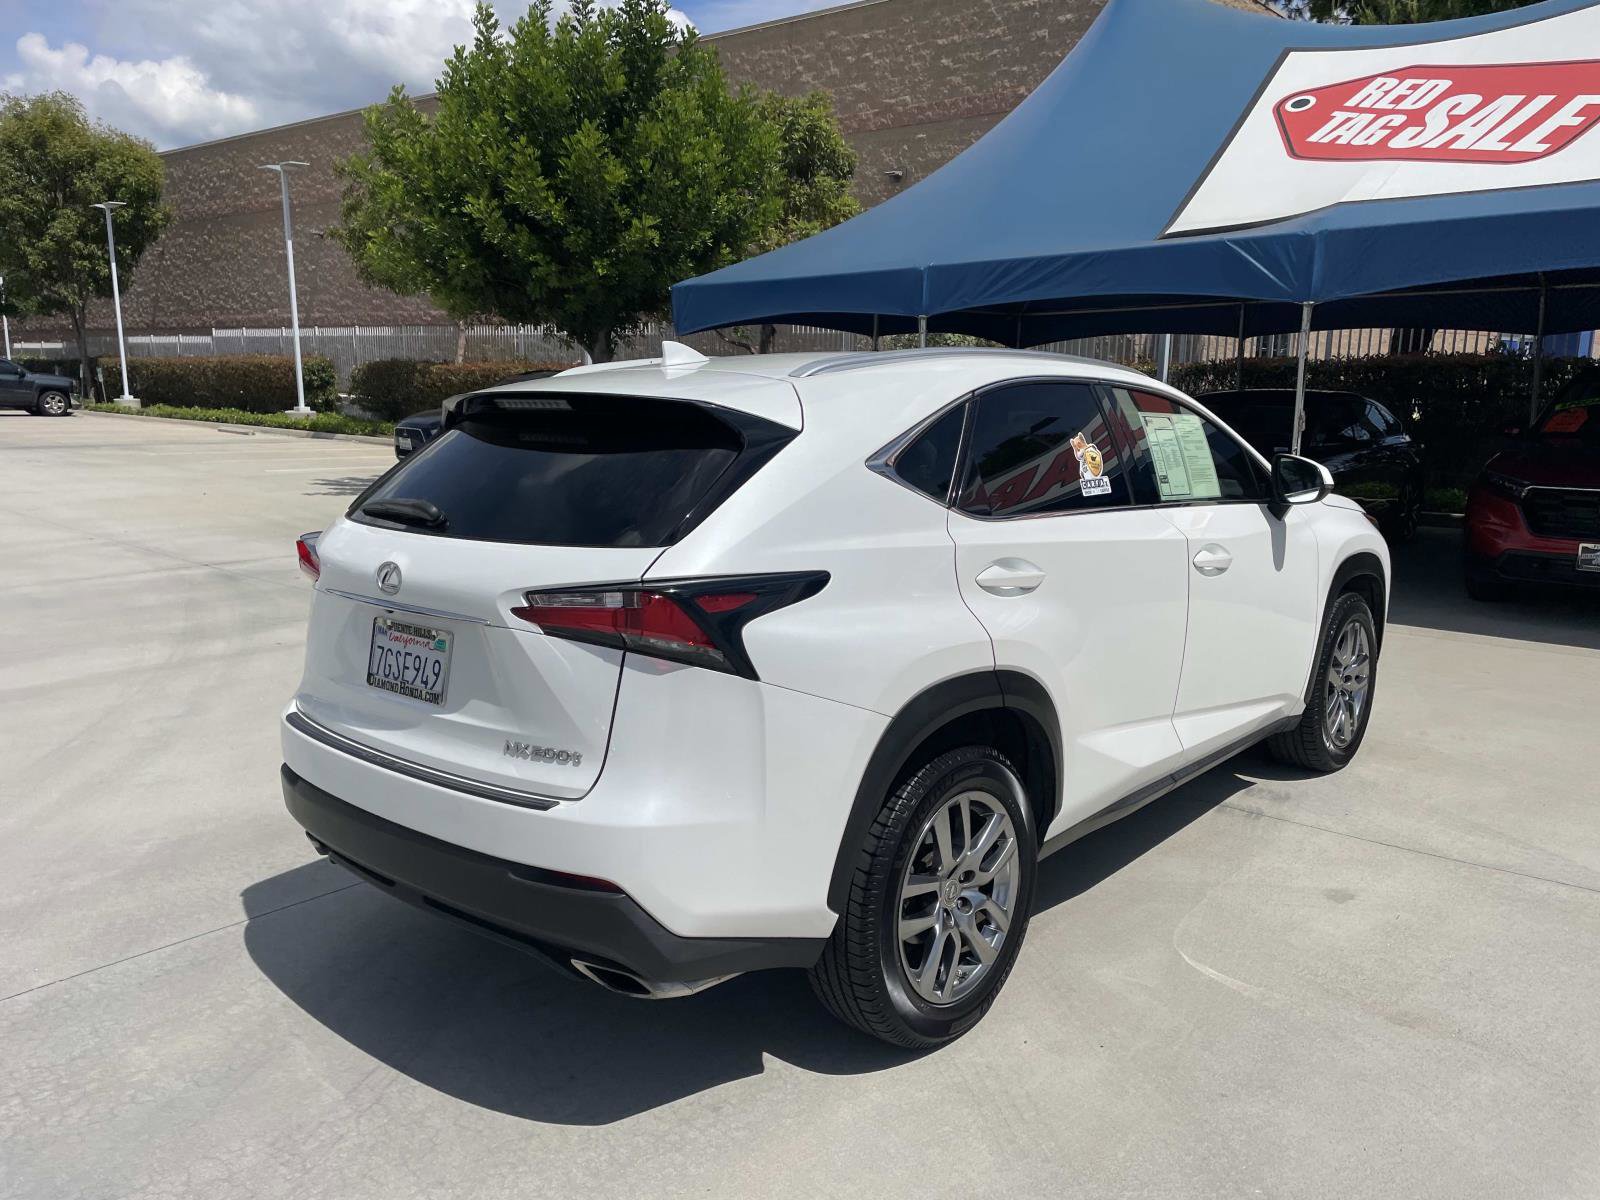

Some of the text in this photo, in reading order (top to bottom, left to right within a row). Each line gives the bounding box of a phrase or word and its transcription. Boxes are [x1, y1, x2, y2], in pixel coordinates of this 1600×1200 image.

[1343, 76, 1453, 111] RED
[1306, 110, 1410, 146] TAG
[1386, 92, 1600, 153] SALE
[376, 645, 442, 690] 7GSE949
